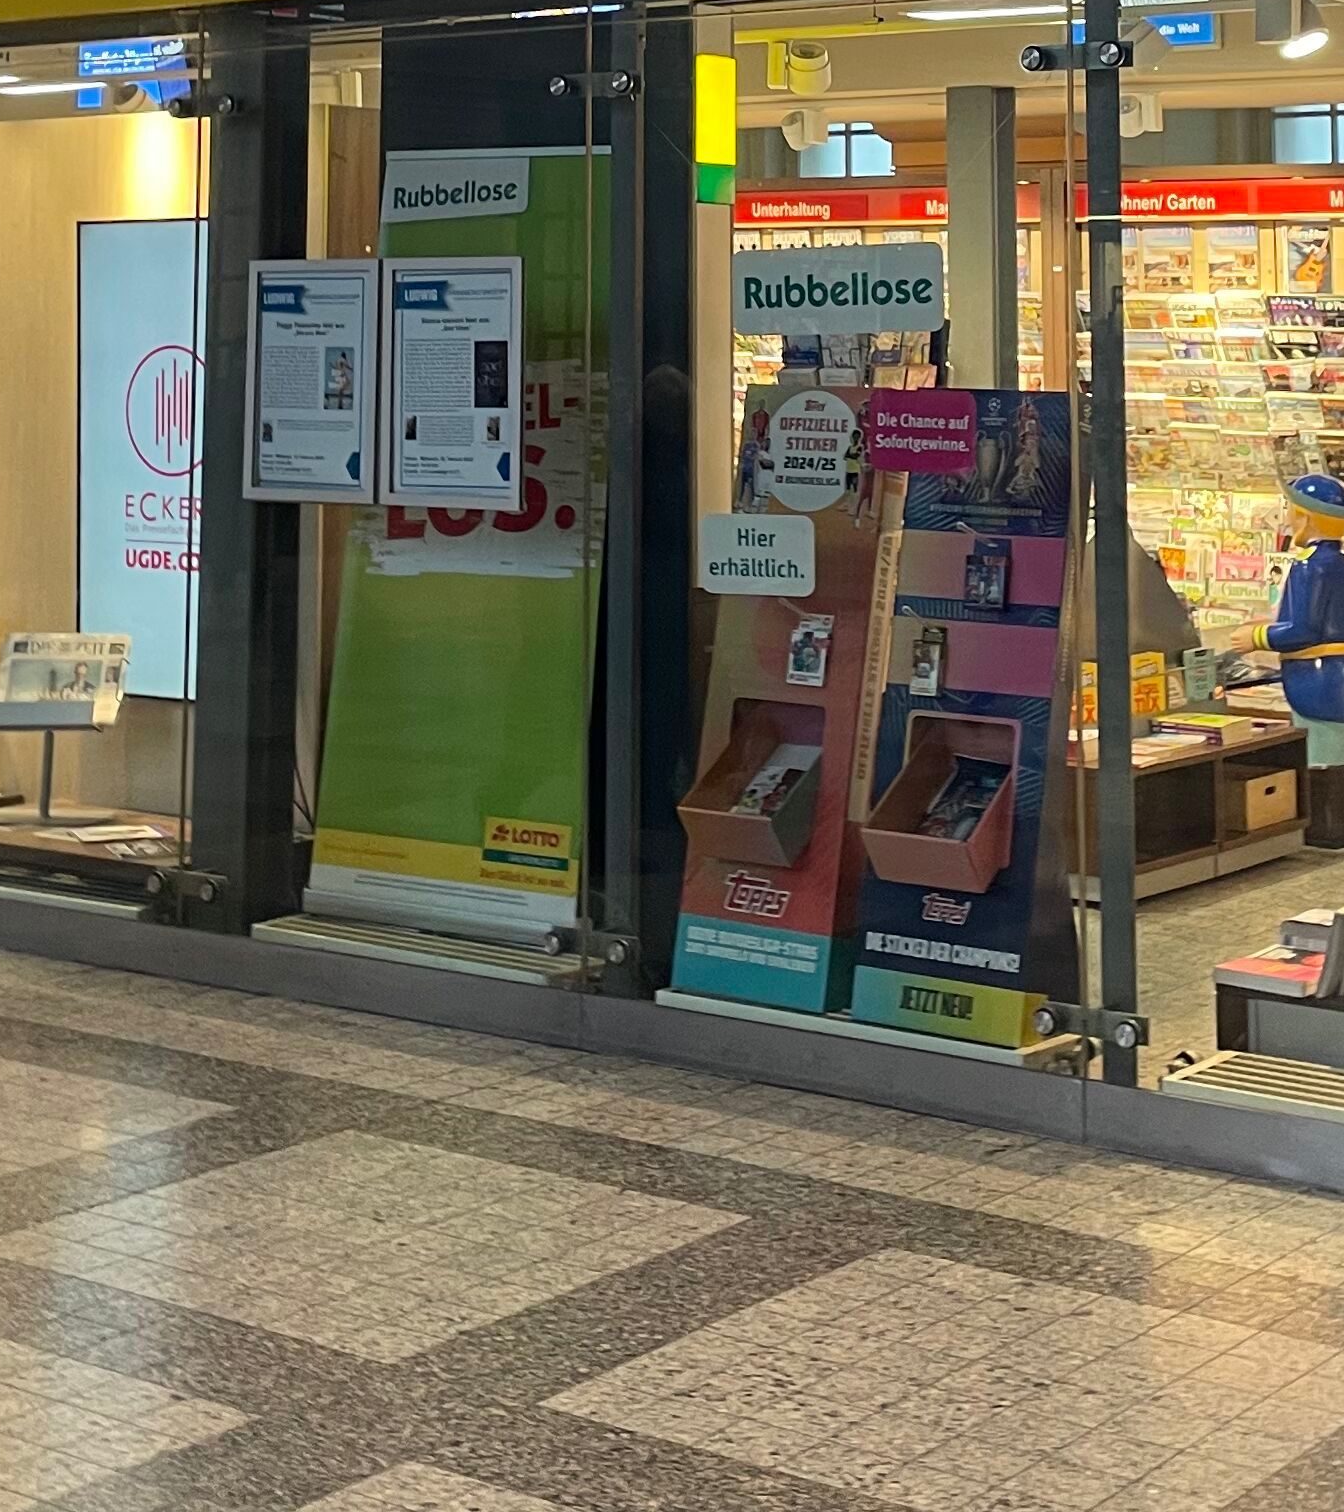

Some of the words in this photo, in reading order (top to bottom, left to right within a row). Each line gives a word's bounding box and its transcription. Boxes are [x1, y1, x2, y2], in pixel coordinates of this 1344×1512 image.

[393, 180, 518, 210] Rubbellose
[1167, 193, 1216, 211] Garten
[751, 202, 831, 220] Unterhaltung
[743, 272, 933, 311] Rubbellose
[780, 417, 848, 433] OFFIZIELLE
[877, 412, 897, 428] Die
[900, 413, 945, 429] Chance
[948, 415, 970, 430] auf
[785, 437, 837, 452] STICKER
[875, 434, 970, 453] Sofortgewinne.
[783, 456, 836, 471] 2024/25
[785, 475, 840, 486] BUNDESLIGA
[736, 528, 776, 548] Hier
[709, 556, 805, 580] erhältlich.
[512, 827, 559, 848] LOTTO
